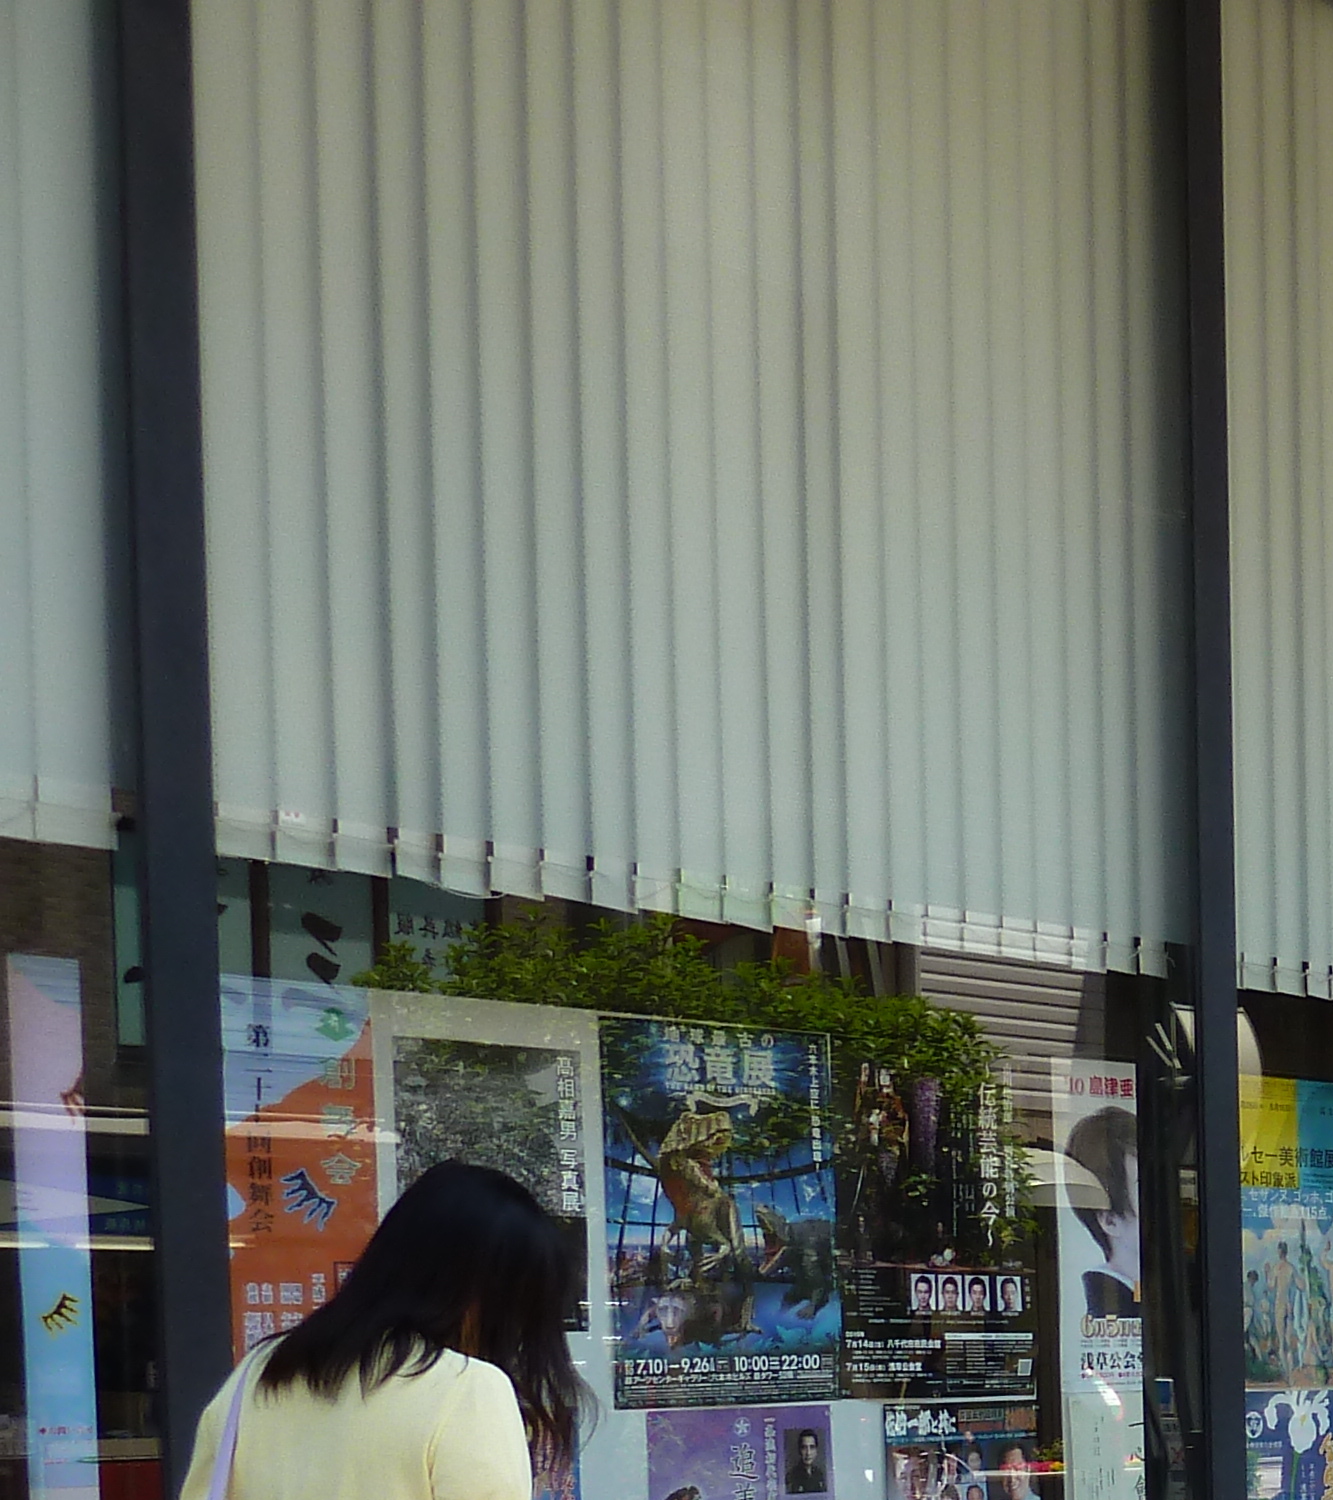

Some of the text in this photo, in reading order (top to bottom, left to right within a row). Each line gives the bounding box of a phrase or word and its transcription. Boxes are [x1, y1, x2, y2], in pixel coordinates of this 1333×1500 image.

[664, 1042, 777, 1089] 恐竜展
[681, 1357, 710, 1373] 9.26
[734, 1355, 769, 1371] 10:00
[781, 1354, 820, 1369] 22:00
